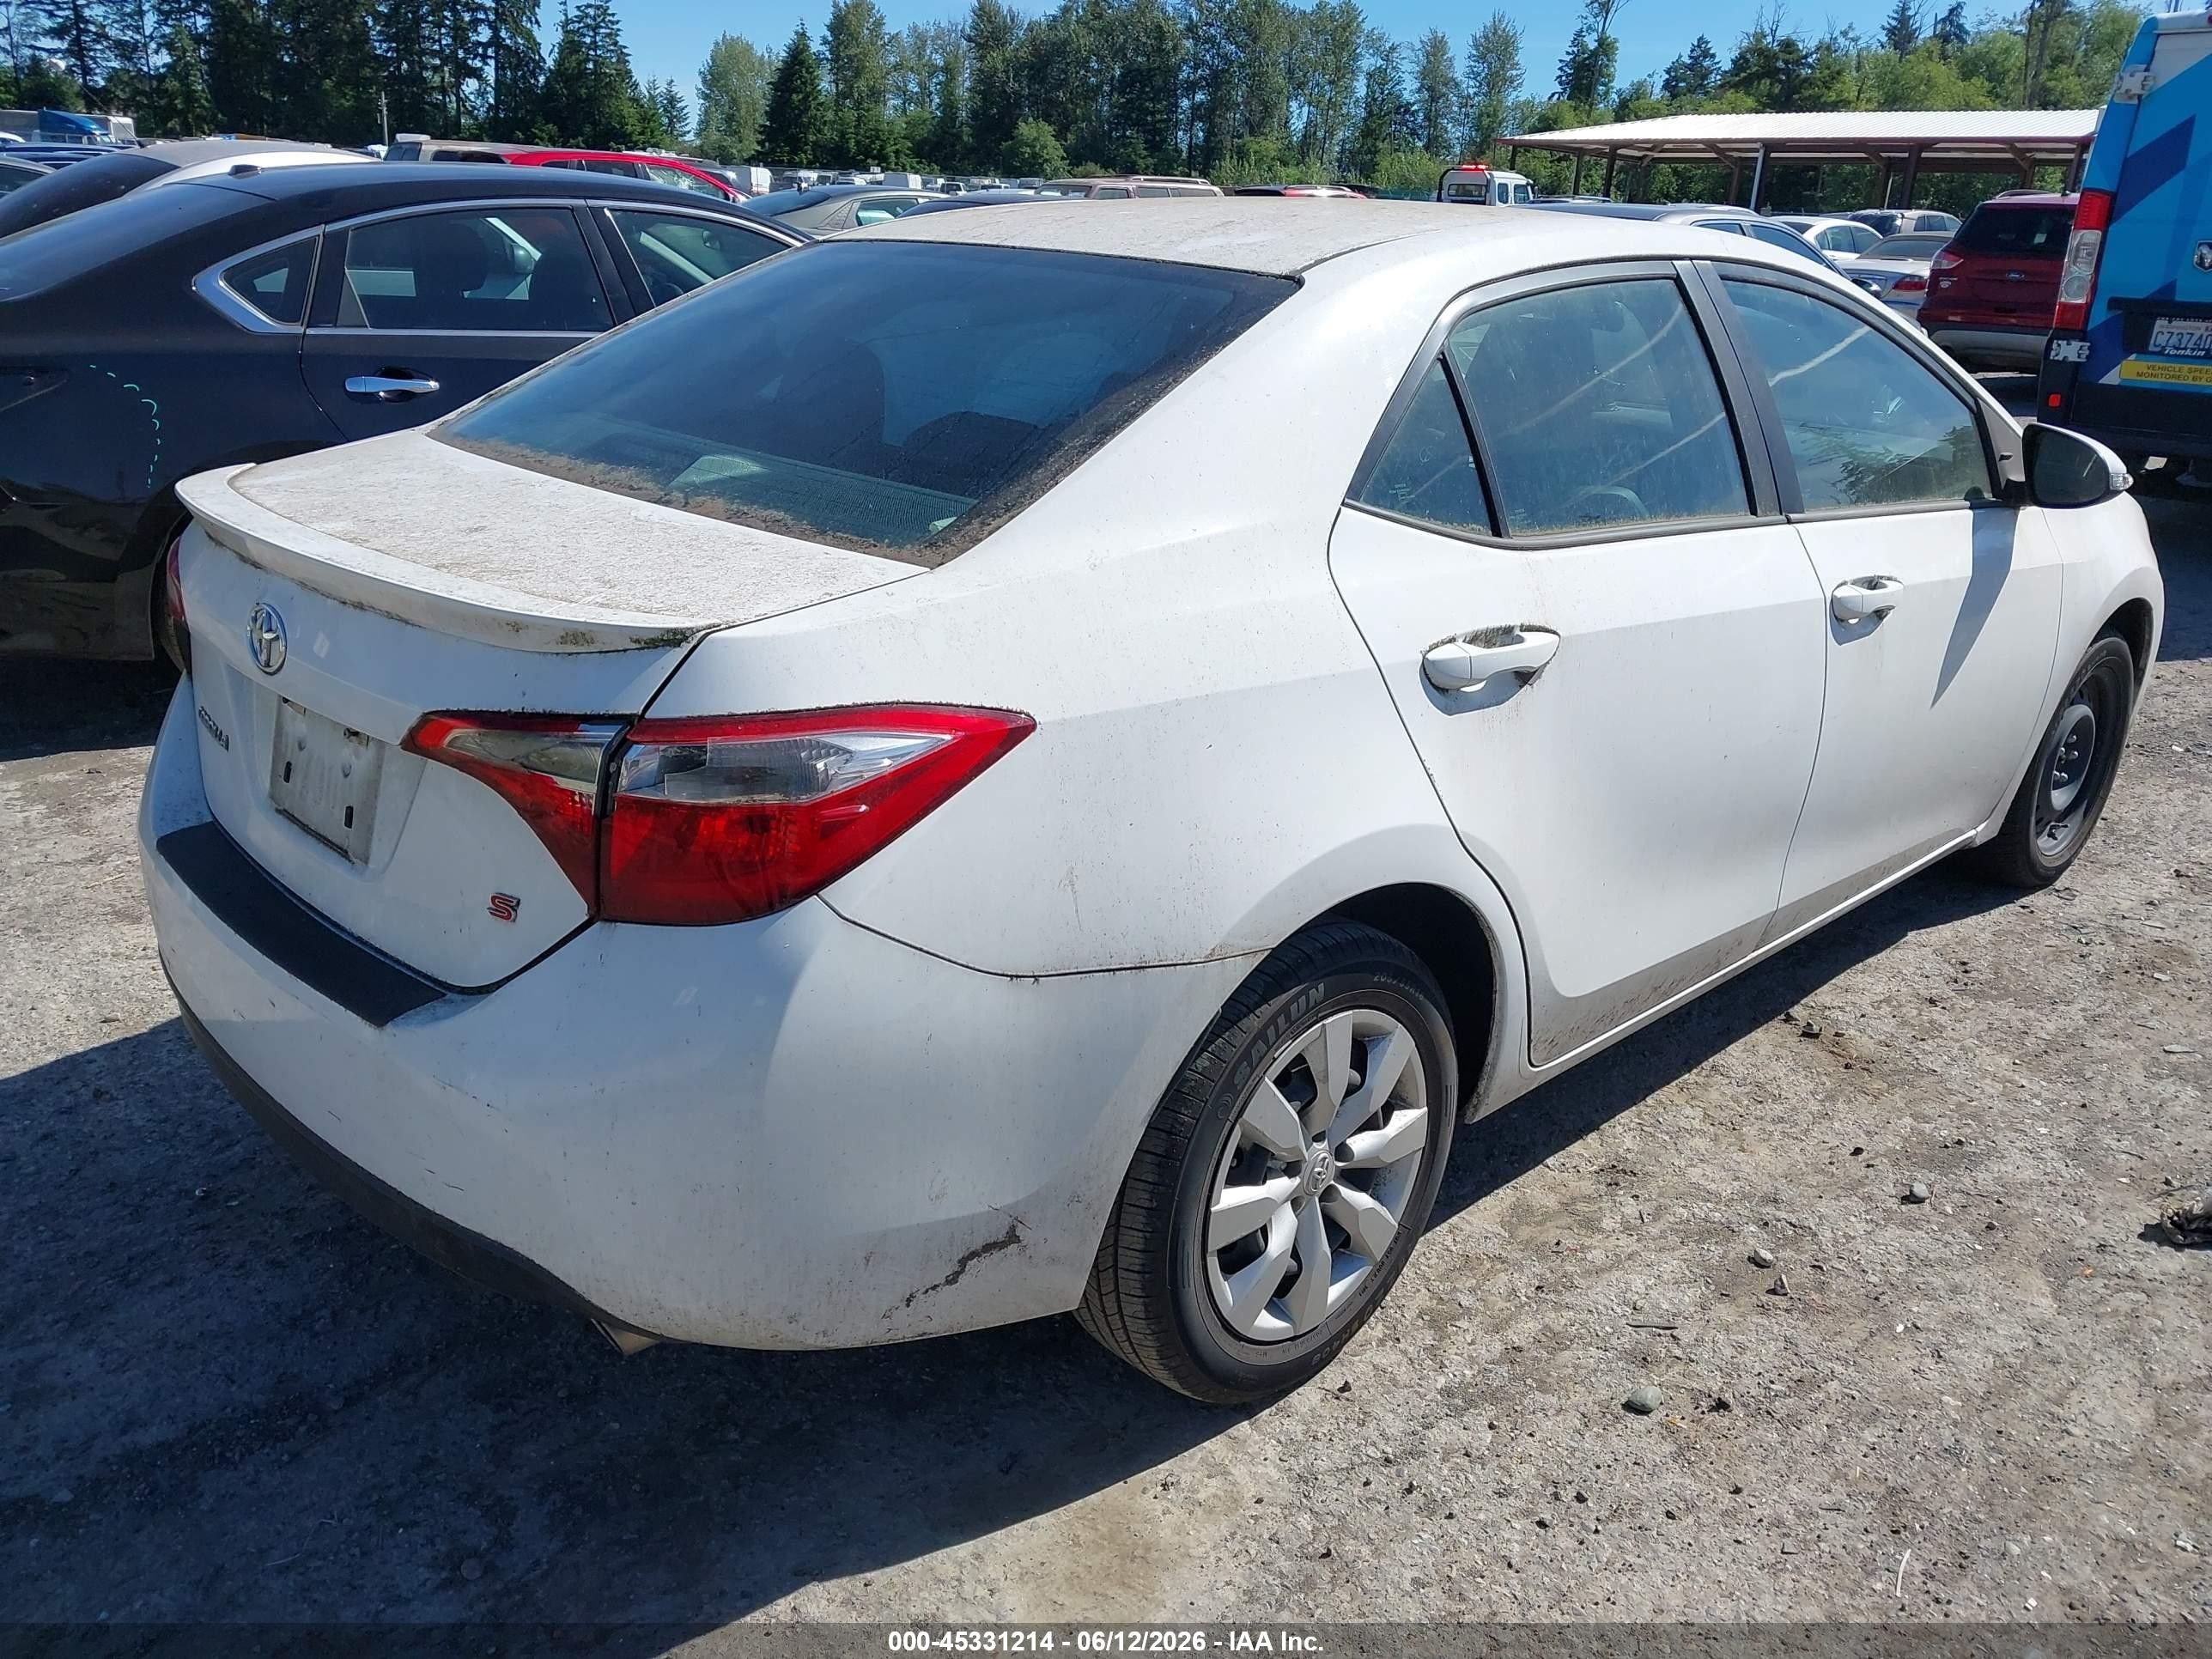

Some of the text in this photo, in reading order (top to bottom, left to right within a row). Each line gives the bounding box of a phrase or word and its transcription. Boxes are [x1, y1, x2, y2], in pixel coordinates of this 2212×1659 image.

[2163, 347, 2206, 356] Tonkin
[2147, 364, 2212, 375] VEHICLE SPEE
[2136, 371, 2190, 381] MONITORED
[487, 892, 520, 922] S
[1234, 982, 1325, 1086] SAILUN
